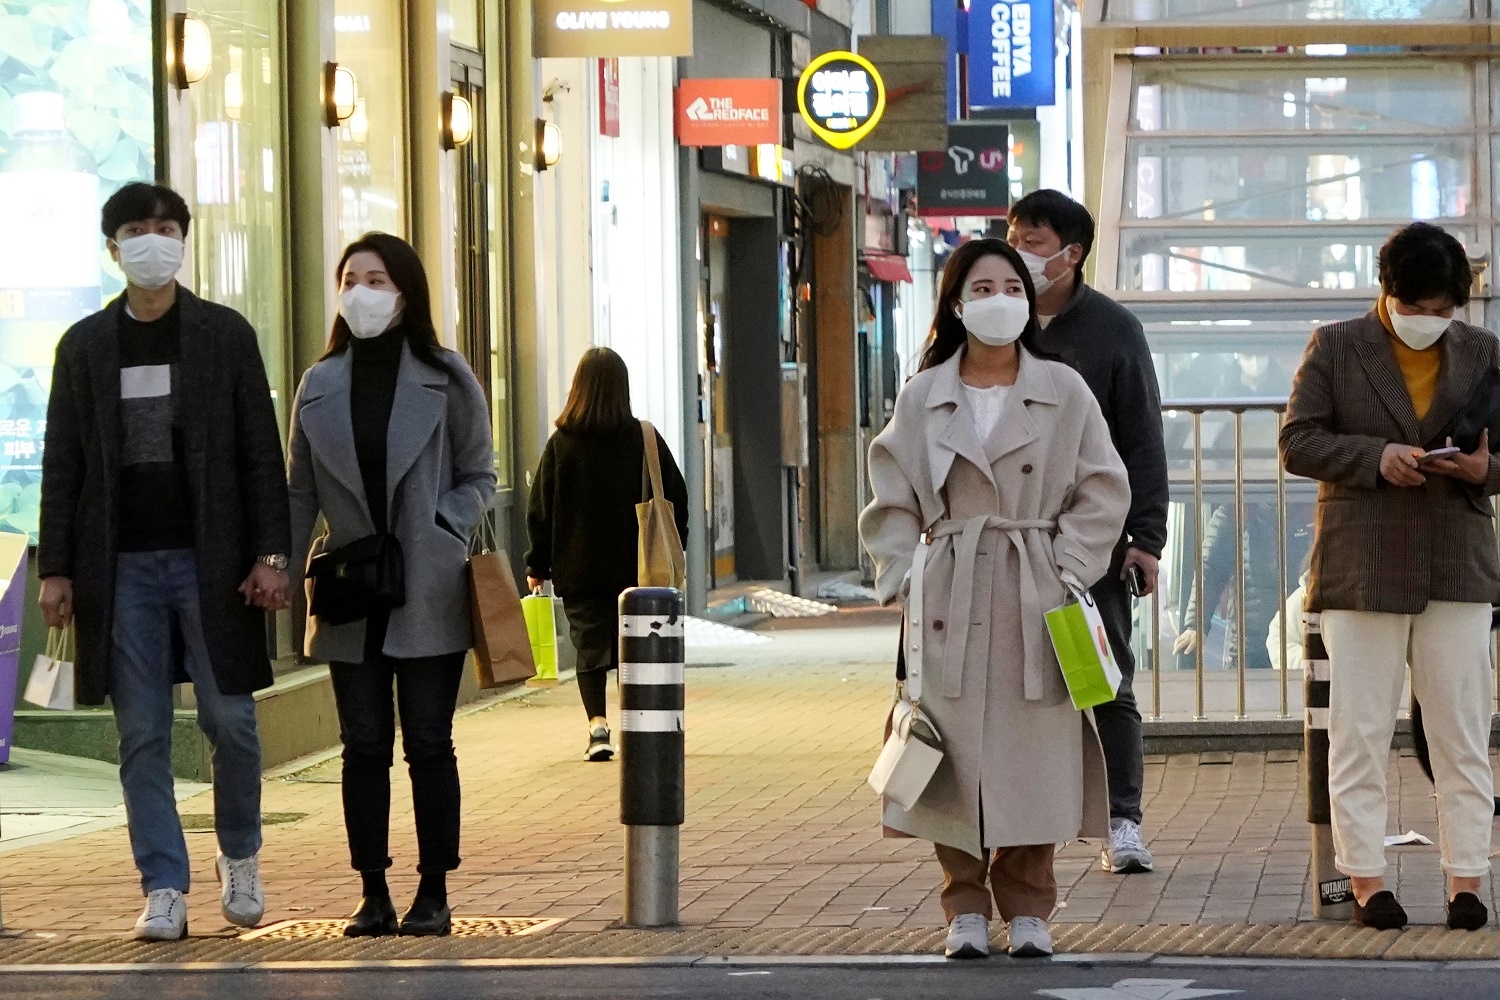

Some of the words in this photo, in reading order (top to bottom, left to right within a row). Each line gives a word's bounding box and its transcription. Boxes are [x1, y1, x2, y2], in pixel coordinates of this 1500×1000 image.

[556, 12, 608, 29] OLIVE
[610, 11, 670, 28] YOUNG
[1012, 3, 1032, 77] EDIYA
[991, 3, 1011, 98] COFFEE
[709, 97, 733, 109] THE
[713, 108, 769, 121] REDFACE
